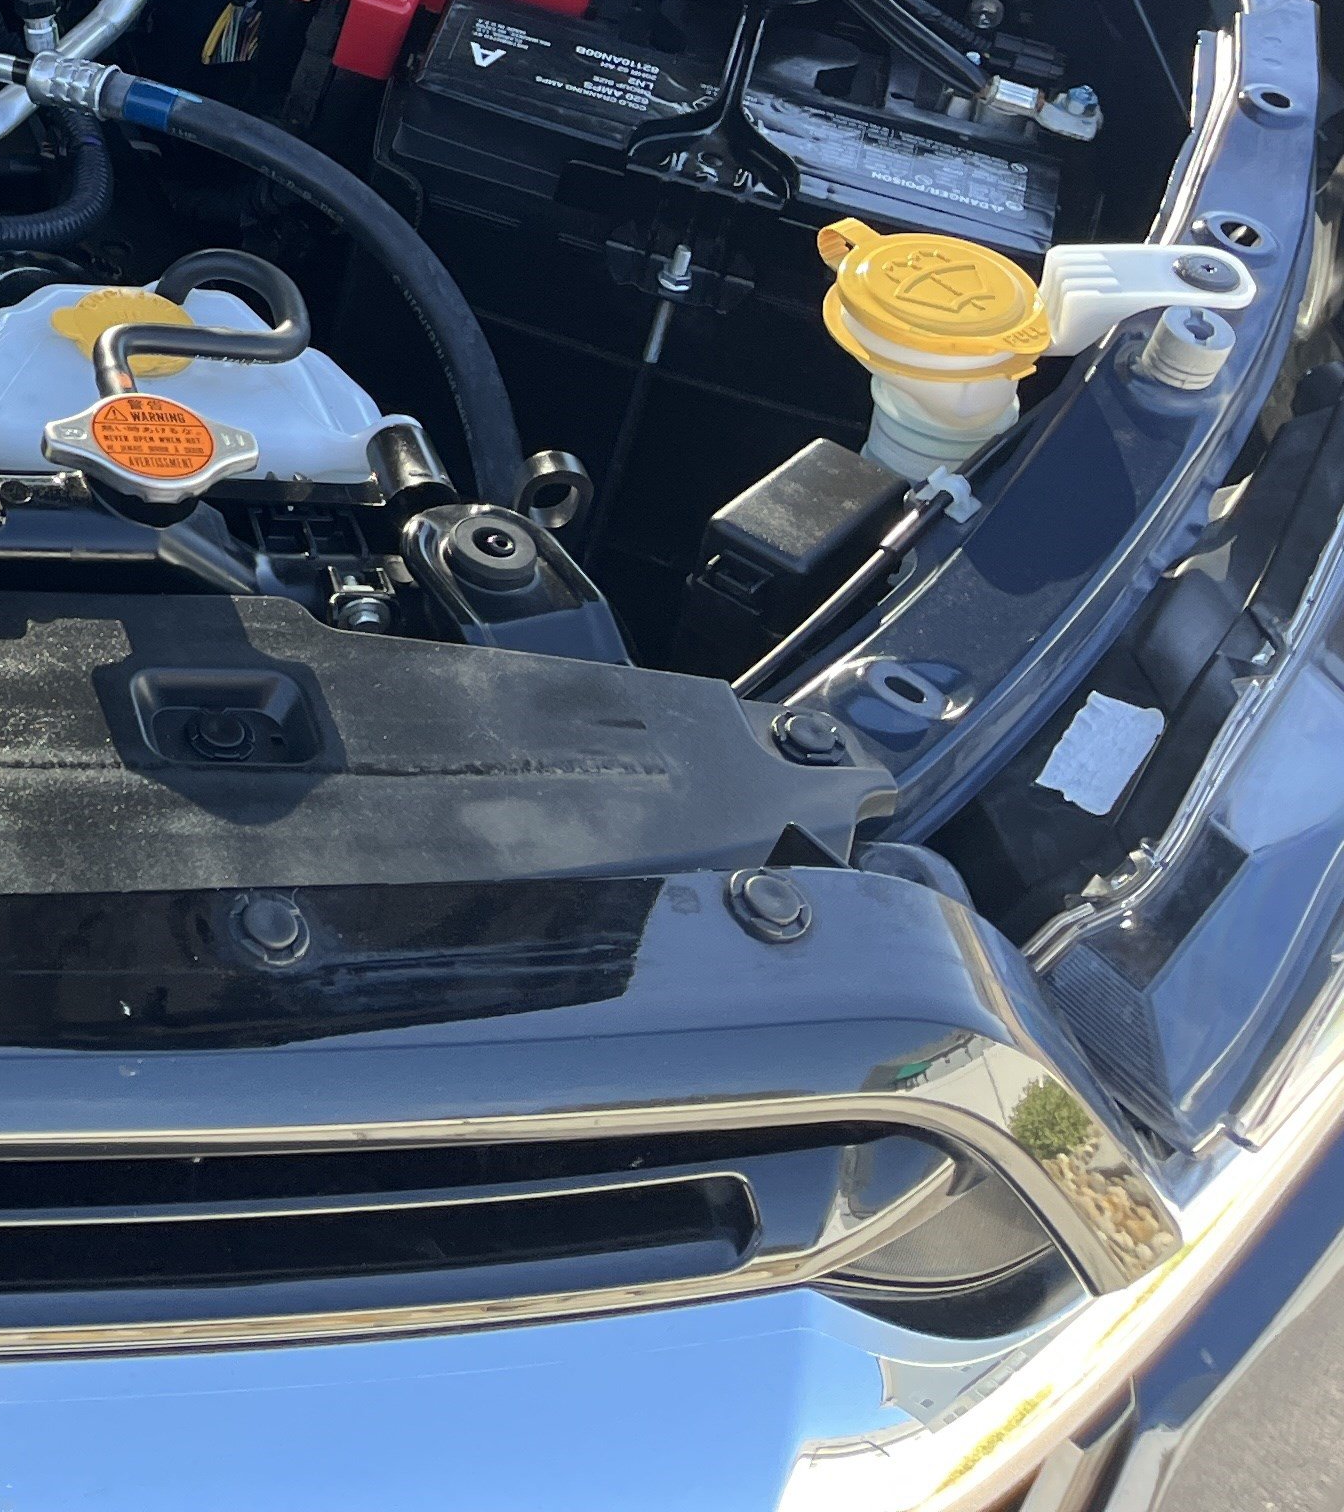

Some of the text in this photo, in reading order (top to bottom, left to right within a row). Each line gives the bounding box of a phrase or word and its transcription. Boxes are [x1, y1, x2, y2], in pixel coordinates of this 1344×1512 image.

[468, 40, 508, 70] A
[534, 74, 647, 112] COLD CRANKING AMPS
[582, 79, 623, 98] AMPS
[870, 169, 990, 209] DANGER/POISON
[129, 410, 186, 423] WARNING
[103, 433, 129, 442] NEVER
[132, 434, 155, 442] OPEN
[158, 435, 182, 443] WHEN
